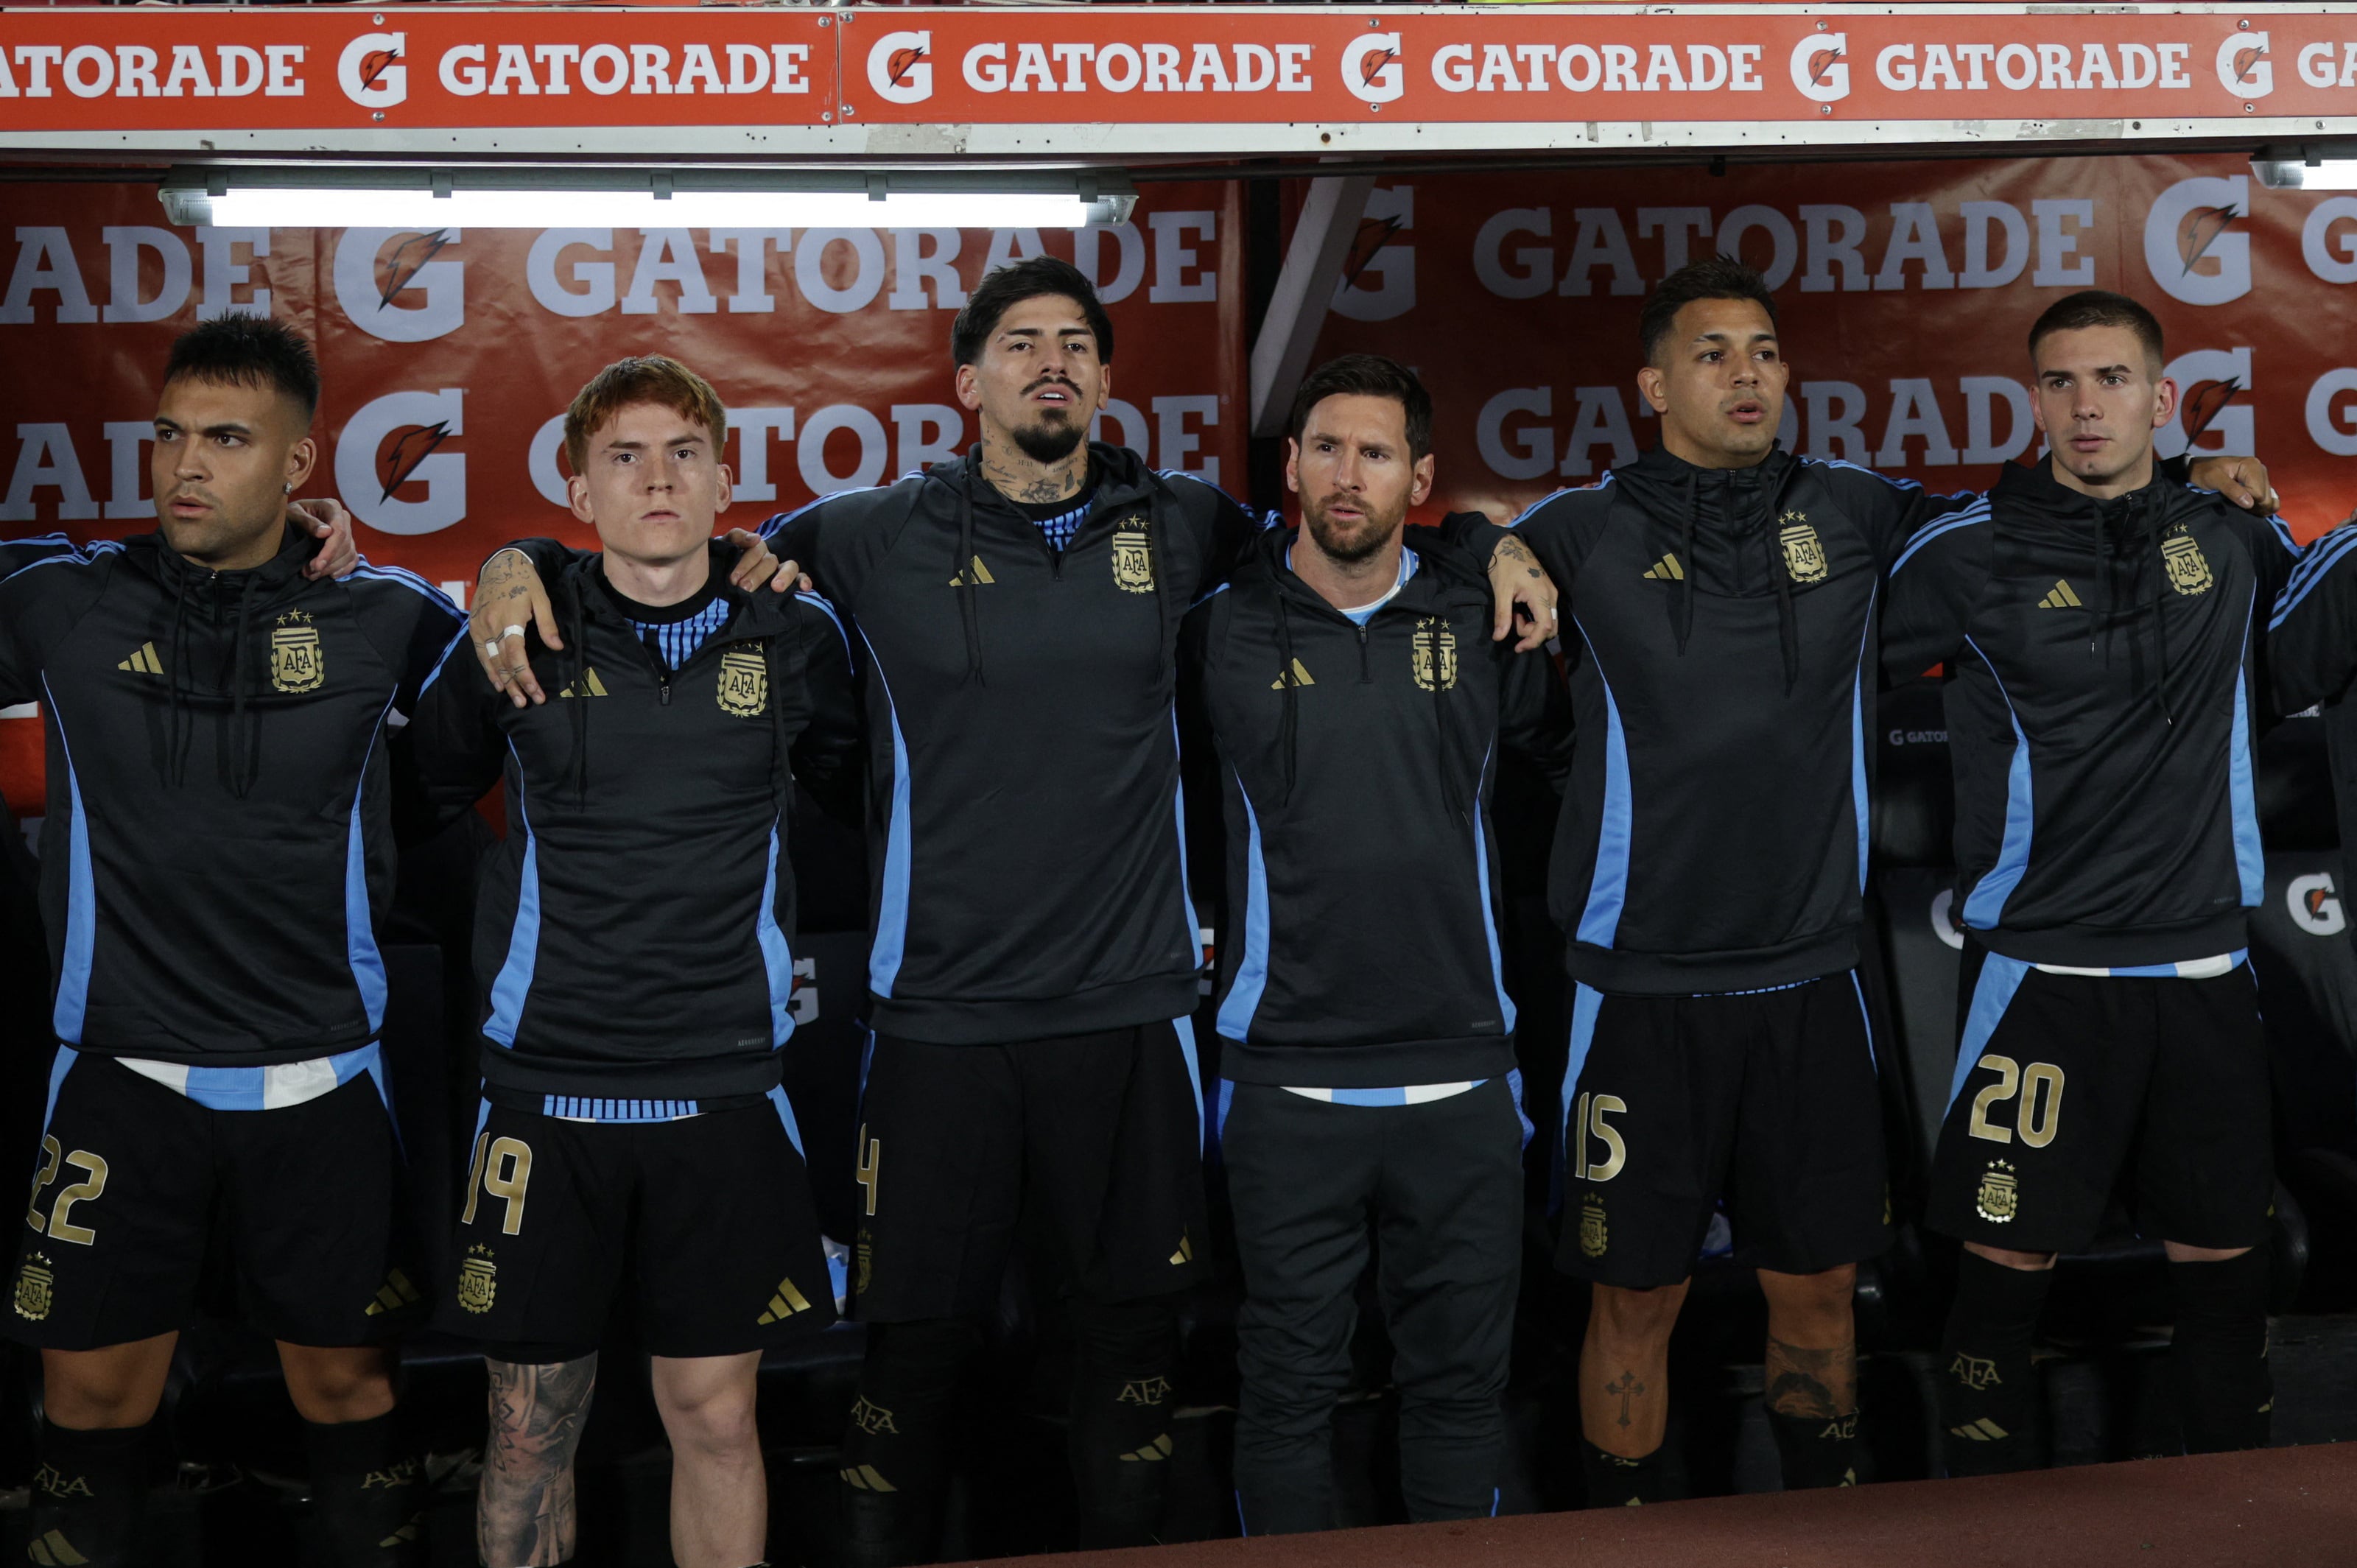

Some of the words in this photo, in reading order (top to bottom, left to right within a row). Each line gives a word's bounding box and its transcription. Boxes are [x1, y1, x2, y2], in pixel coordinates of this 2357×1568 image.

[337, 32, 407, 108] G
[438, 43, 809, 96] GATORADE
[866, 30, 933, 104] G
[962, 42, 1312, 93] GATORADE
[1341, 32, 1405, 103] G
[1431, 43, 1763, 93] GATORADE
[1789, 32, 1850, 102] G
[1875, 43, 2191, 91] GATORADE
[2216, 30, 2275, 99] G
[0, 225, 272, 325] ADE
[1472, 200, 2096, 300] GATORADE
[2143, 175, 2252, 306] G
[333, 227, 465, 343] G
[334, 388, 468, 536] G
[527, 394, 1220, 509] TORDE
[1475, 376, 2048, 482] GARAD
[0, 421, 158, 521] AD
[1123, 548, 1148, 577] AFA
[1794, 541, 1818, 566] AFA
[2174, 552, 2200, 577] AFA
[284, 645, 313, 675] AFA
[728, 668, 756, 700] AFA
[1423, 648, 1448, 671] AA
[1888, 728, 1905, 746] G
[2286, 871, 2347, 937] G
[1969, 1053, 2065, 1149] 20
[1574, 1091, 1628, 1182] 15
[26, 1133, 109, 1246] 22
[461, 1132, 533, 1236] 19
[1985, 1185, 2009, 1210] AFA
[465, 1273, 487, 1299] AFA
[1116, 1374, 1173, 1407] AFA
[1948, 1350, 2003, 1391] AFA
[849, 1393, 901, 1437] AFA
[34, 1460, 95, 1499] AFA
